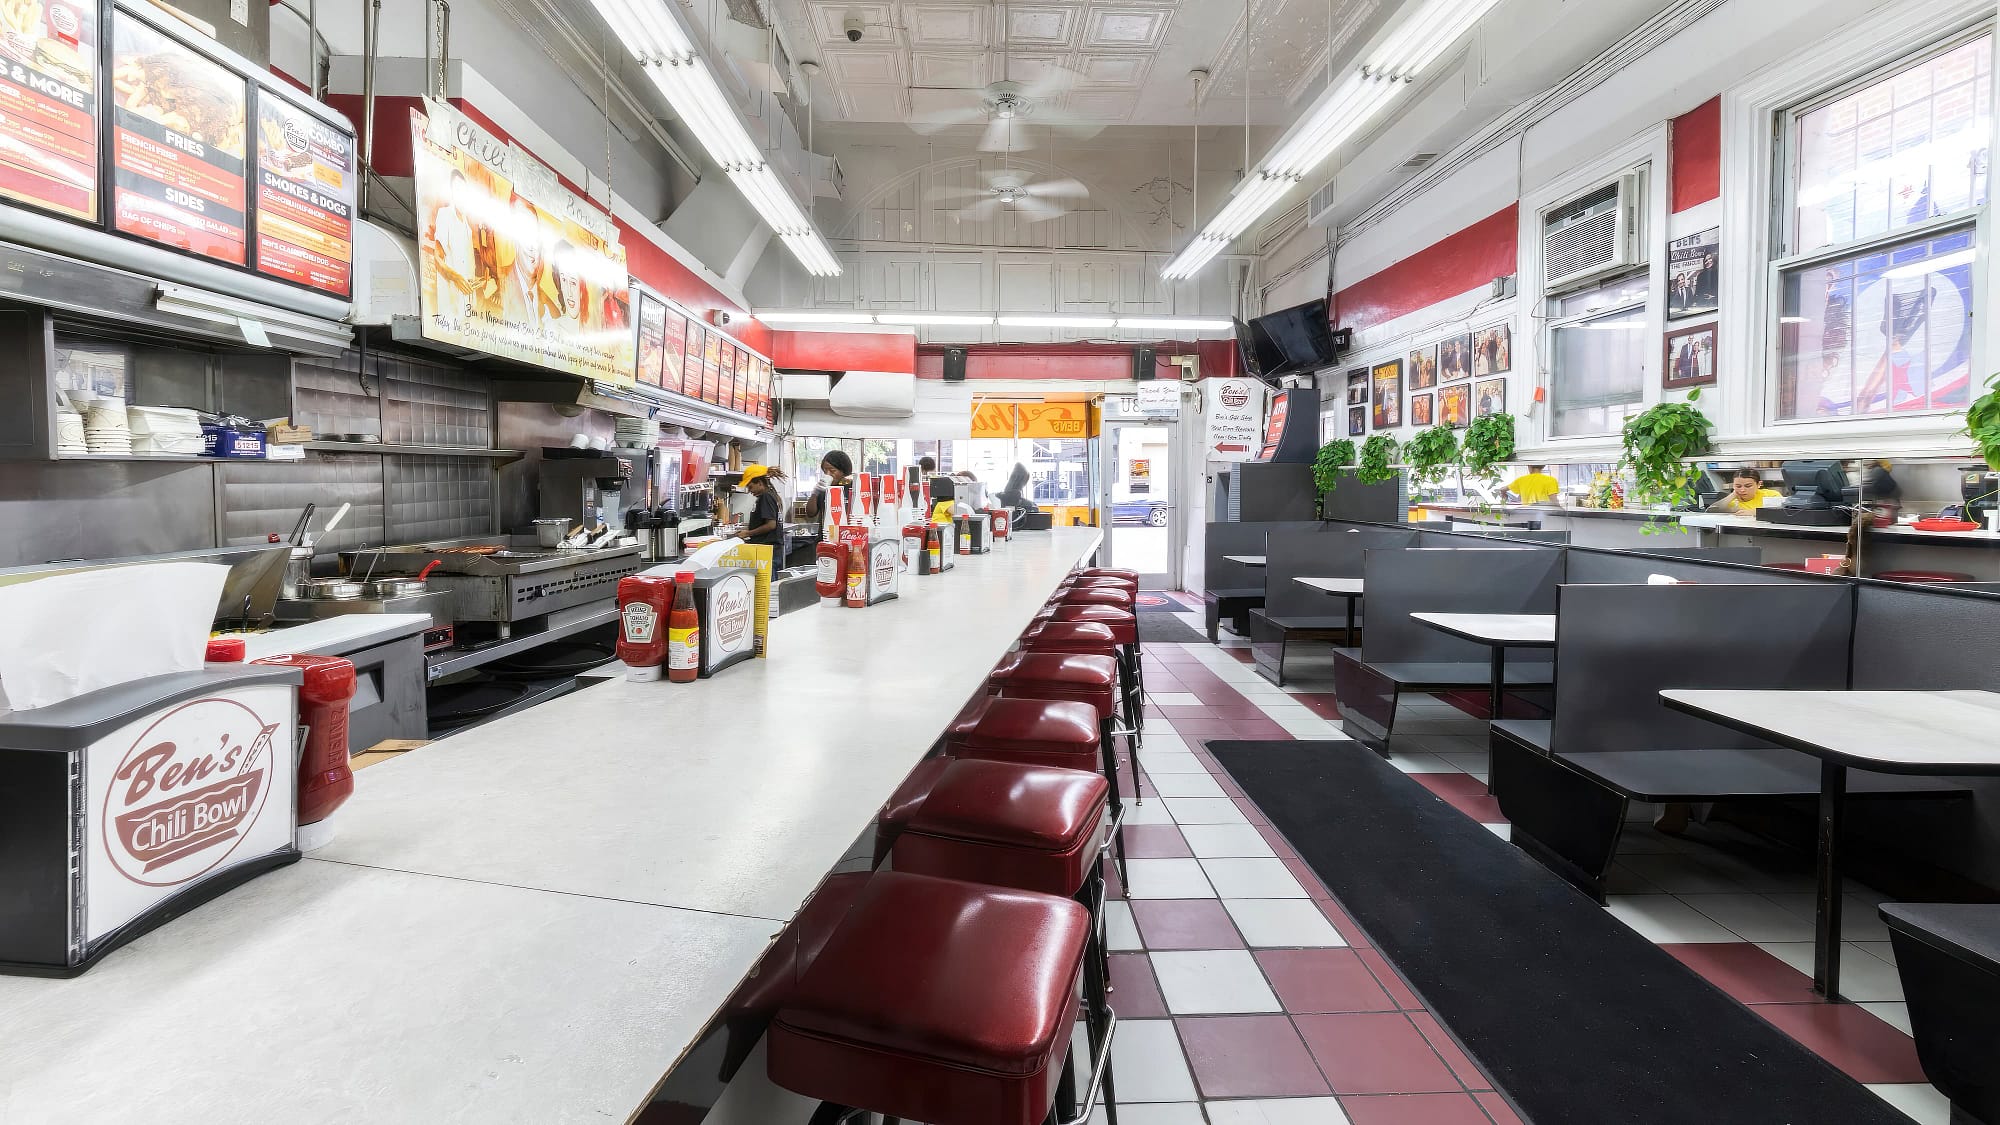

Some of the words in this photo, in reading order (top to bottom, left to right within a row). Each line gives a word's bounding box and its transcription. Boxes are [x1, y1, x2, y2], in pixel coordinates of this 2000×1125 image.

[30, 72, 84, 108] MORE
[121, 133, 155, 153] FRENCH
[165, 130, 204, 157] FRIES
[309, 129, 345, 154] COMBO
[457, 121, 507, 173] Chili
[165, 187, 204, 212] SIDES
[264, 172, 309, 201] SMOKES
[310, 192, 319, 204] &
[319, 196, 347, 216] DOGS
[121, 210, 139, 222] BAG
[140, 216, 152, 225] OF
[153, 220, 177, 234] CHIPS
[207, 221, 229, 234] SALAD
[1221, 385, 1246, 396] Ben's
[1273, 401, 1288, 416] ATM
[717, 591, 743, 616] Ben's
[117, 733, 242, 806] Ben's
[131, 811, 188, 852] Chili
[193, 787, 248, 832] Bowl
